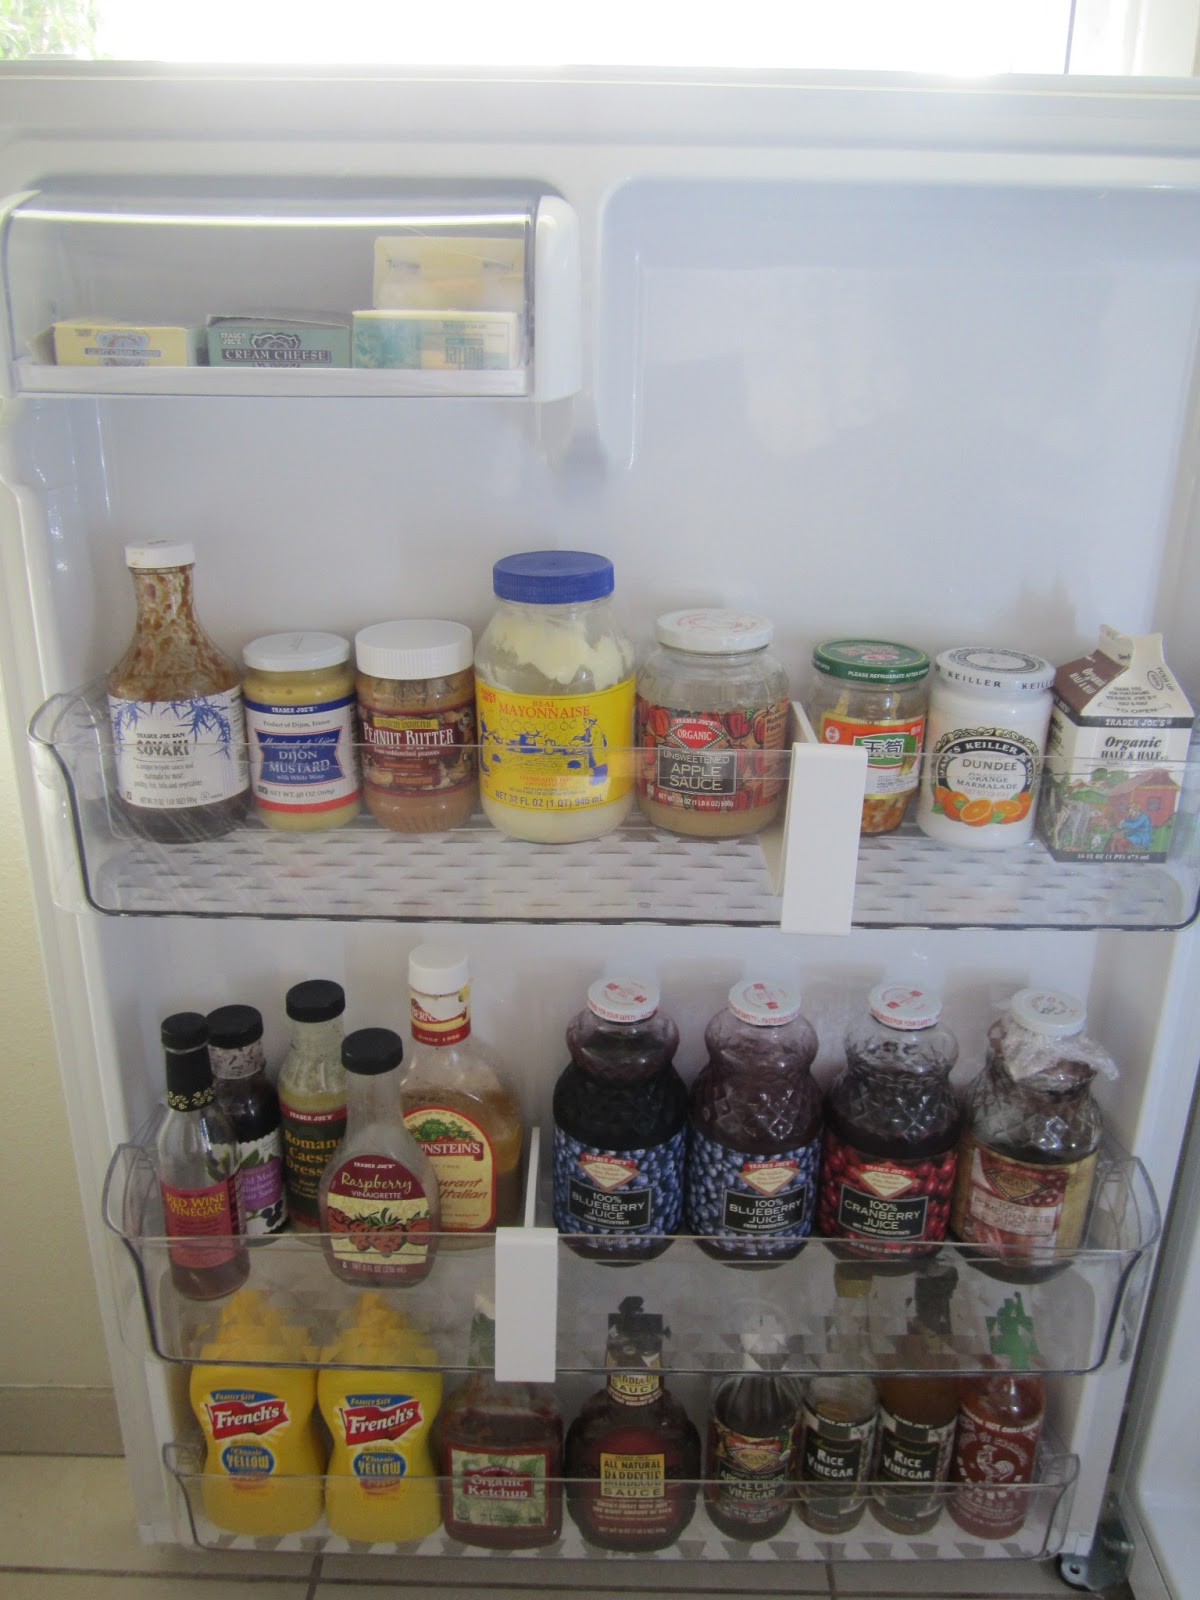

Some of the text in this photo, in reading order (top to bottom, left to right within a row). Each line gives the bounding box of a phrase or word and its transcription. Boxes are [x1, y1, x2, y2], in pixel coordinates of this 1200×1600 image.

[225, 350, 327, 361] CREAM CHEESE
[848, 671, 869, 679] PLEASE
[947, 670, 1002, 688] KEILLER
[1156, 667, 1175, 692] PUSH UP
[499, 702, 590, 719] MAYONNAISE
[532, 700, 556, 708] REAL
[263, 720, 283, 728] Product
[312, 719, 331, 727] France
[766, 722, 782, 733] Facts
[1105, 718, 1166, 727] TRADER JOE'S
[363, 722, 454, 746] PEANUT BUTTER
[677, 730, 712, 741] ORGANIC
[136, 739, 190, 757] SOYAKI
[965, 741, 1018, 755] KEILLER
[1104, 736, 1162, 750] Organic
[278, 750, 318, 763] DIJON
[663, 751, 729, 764] UNSWEETENED
[1101, 750, 1161, 761] HALF & HALF
[269, 759, 330, 774] MUSTARD
[671, 762, 722, 777] APPLE
[962, 758, 1018, 771] DUNDEE
[669, 777, 723, 791] SAUCE
[968, 772, 1009, 783] ORANGE
[956, 779, 1018, 790] MARMALADE
[495, 790, 507, 800] NET
[508, 794, 518, 803] 32
[519, 796, 530, 806] FL
[532, 797, 543, 807] OZ
[545, 798, 554, 808] (1
[557, 797, 573, 808] QT)
[575, 795, 590, 806] 946
[591, 794, 603, 804] mL
[761, 1015, 790, 1024] PASTEURIZED
[417, 1034, 439, 1043] SINCE
[289, 1111, 312, 1121] TRADER
[289, 1146, 331, 1163] Caesa
[420, 1142, 481, 1155] NSTEIN'S
[286, 1156, 324, 1176] Dress
[353, 1161, 375, 1169] TRADER
[586, 1154, 627, 1166] TRADER JOE'S
[865, 1165, 889, 1173] TRADER
[341, 1171, 412, 1194] Raspberry
[438, 1177, 484, 1188] urant
[166, 1191, 225, 1209] RED WINE
[351, 1190, 402, 1199] VINAIGRETTE
[439, 1188, 489, 1200] Italian
[593, 1192, 622, 1204] 100%
[571, 1191, 645, 1212] BLUEBERRY
[729, 1199, 802, 1216] BLUEBERRY
[755, 1198, 784, 1208] 100%
[869, 1200, 898, 1212] 100%
[169, 1203, 227, 1217] VINEGAR
[588, 1208, 625, 1220] JUICE
[844, 1199, 921, 1220] CRANBERRY
[974, 1196, 1051, 1224] POMEGRANATE
[748, 1214, 785, 1224] JUICE
[758, 1220, 789, 1229] CONCENTRATE
[863, 1218, 900, 1230] JUICE
[215, 1393, 256, 1401] FAMILY SIZE
[350, 1398, 391, 1406] FAMILY SIZE
[214, 1405, 280, 1429] French's
[348, 1408, 415, 1434] French's
[226, 1453, 269, 1469] YELLOW
[817, 1448, 845, 1467] RICE
[894, 1450, 922, 1468] RICE
[358, 1460, 401, 1475] YELLOW
[604, 1460, 661, 1469] ALL NATURAL
[807, 1453, 854, 1478] VINEGAR
[883, 1454, 931, 1479] VINEGAR
[470, 1474, 525, 1487] Organic
[604, 1470, 661, 1487] BARBECUE
[467, 1485, 528, 1498] Ketchup
[603, 1487, 662, 1497] SAUCE
[728, 1485, 776, 1501] VINEGAR
